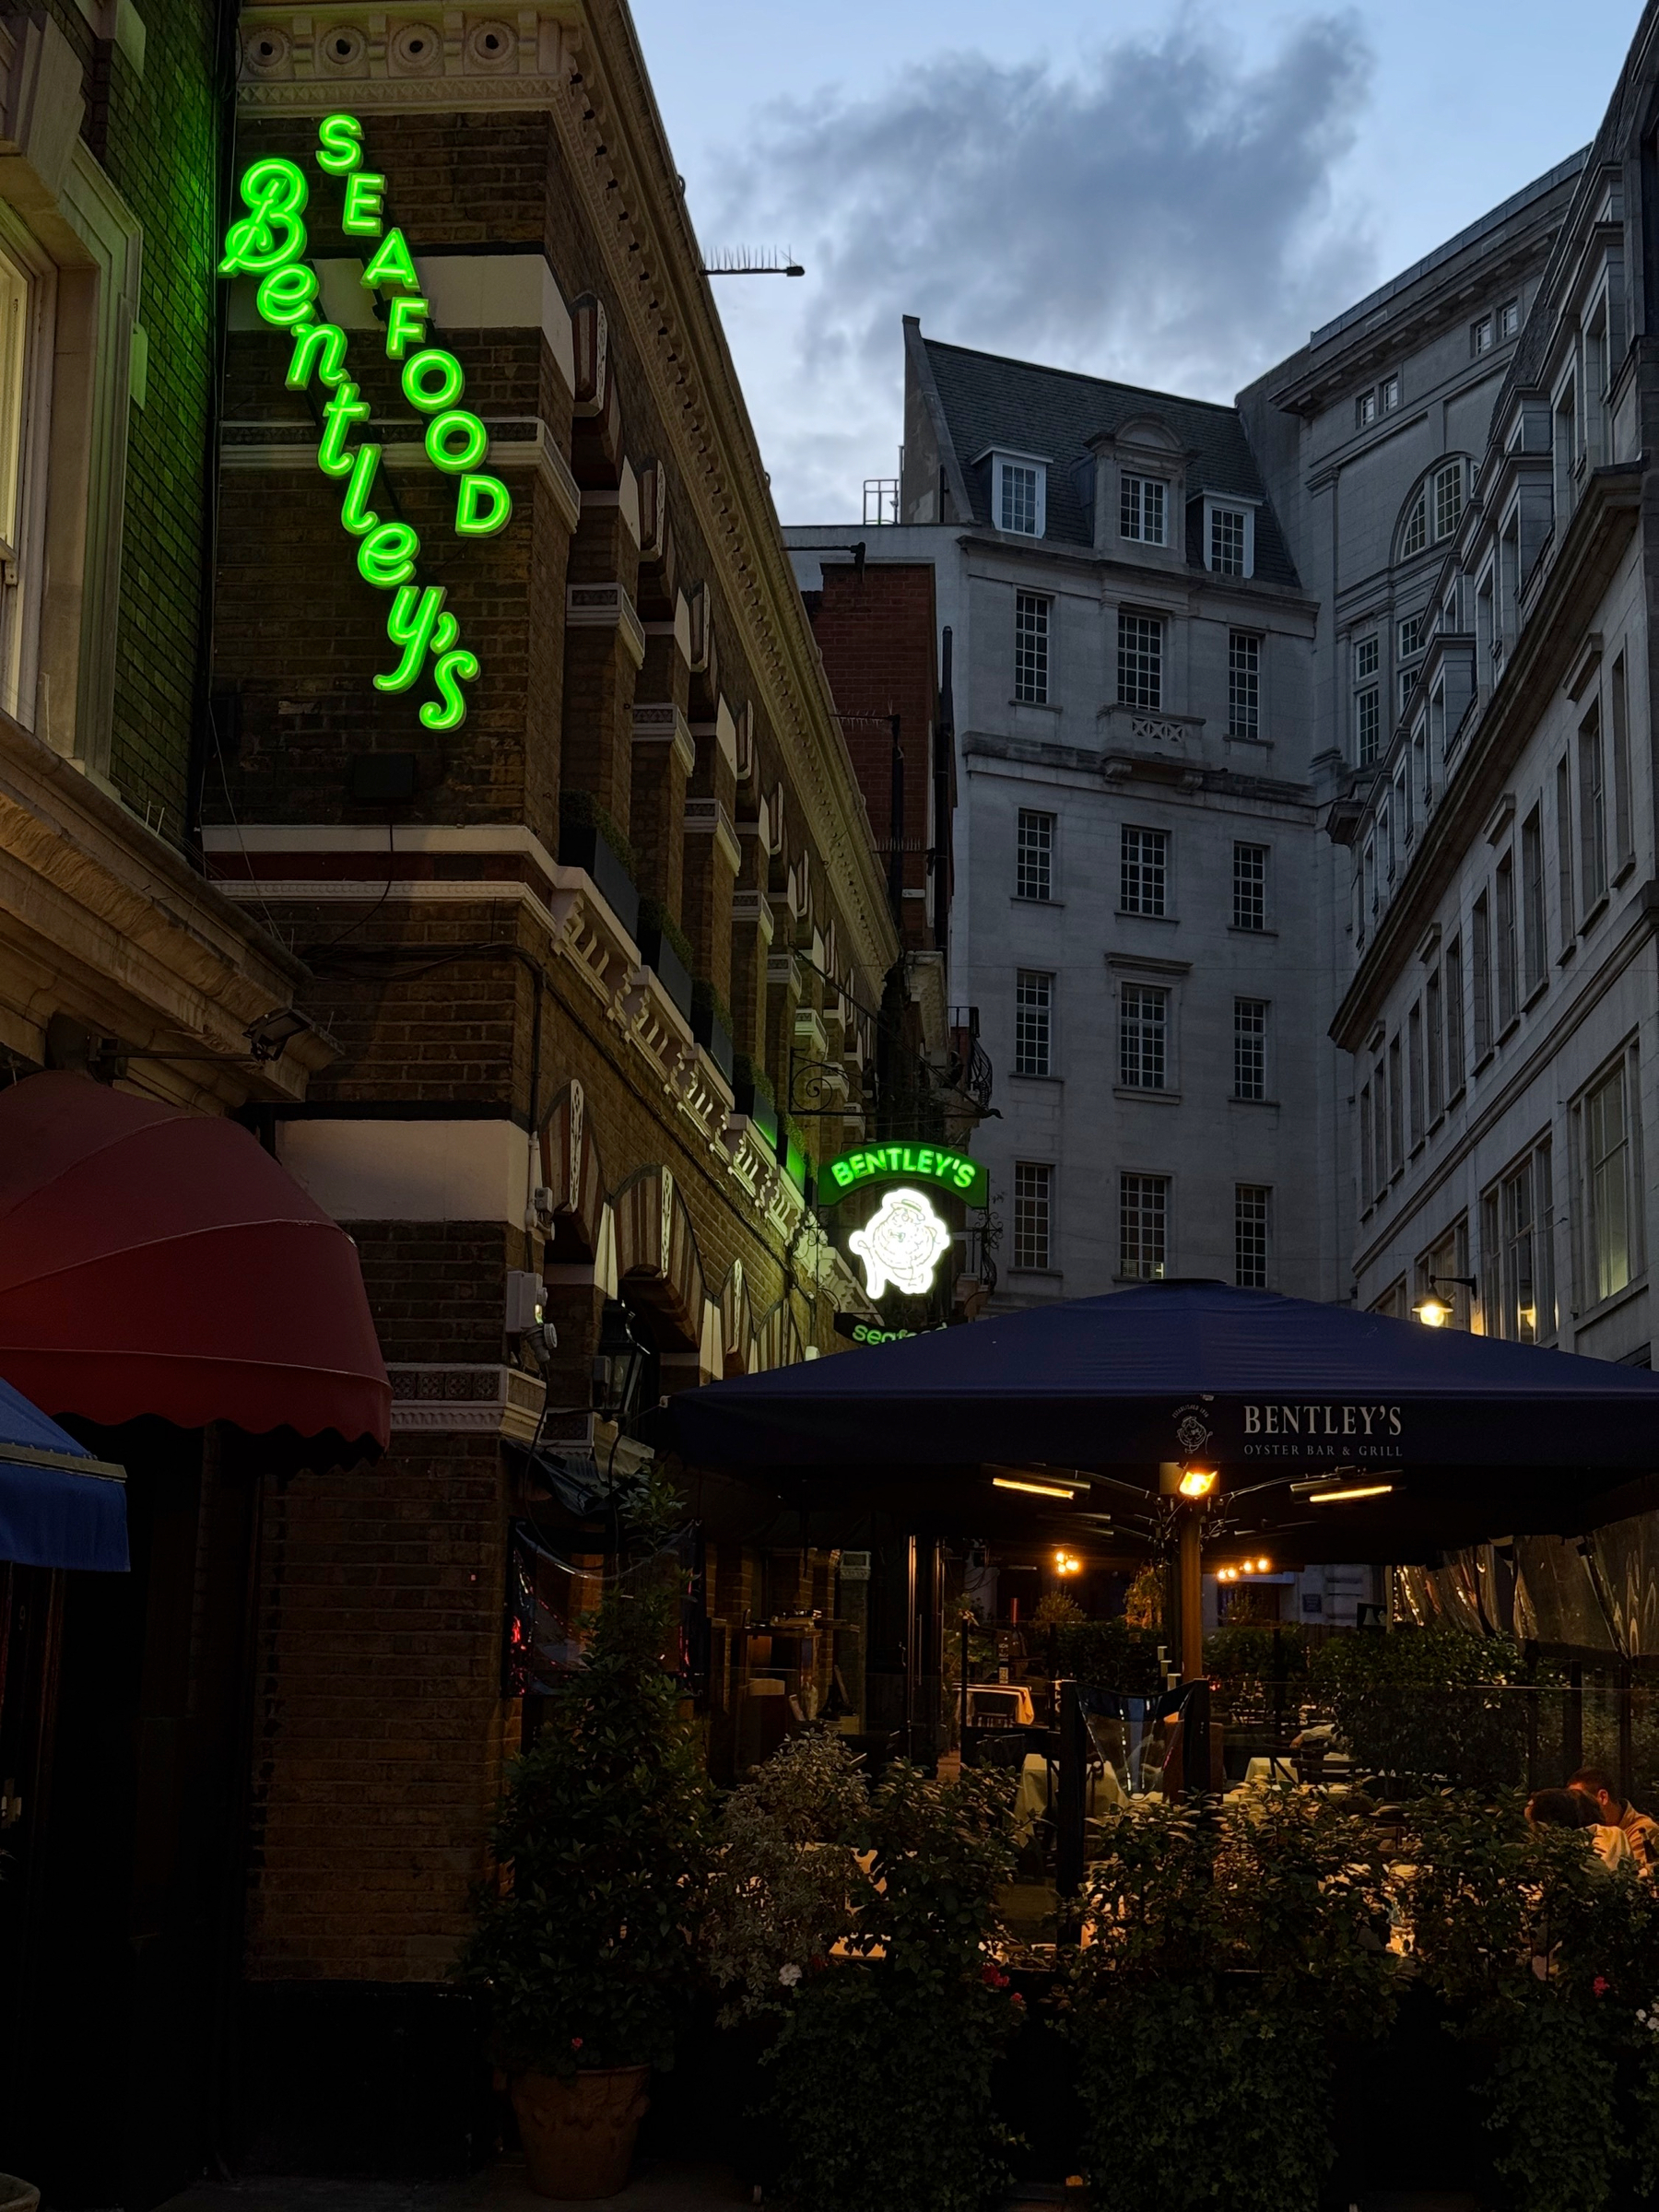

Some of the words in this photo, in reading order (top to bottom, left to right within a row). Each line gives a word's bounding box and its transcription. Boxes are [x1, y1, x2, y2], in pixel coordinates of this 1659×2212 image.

[315, 113, 512, 538] SEAFOOD
[218, 158, 481, 731] Bentley's
[830, 1147, 977, 1189] BENTLEY'S
[852, 1321, 948, 1347] seaf
[1243, 1405, 1403, 1436] BENTLEY'S
[1243, 1444, 1300, 1456] OYSTER
[1306, 1444, 1335, 1456] BAR
[1341, 1445, 1351, 1456] &
[1359, 1445, 1403, 1457] GRILL
